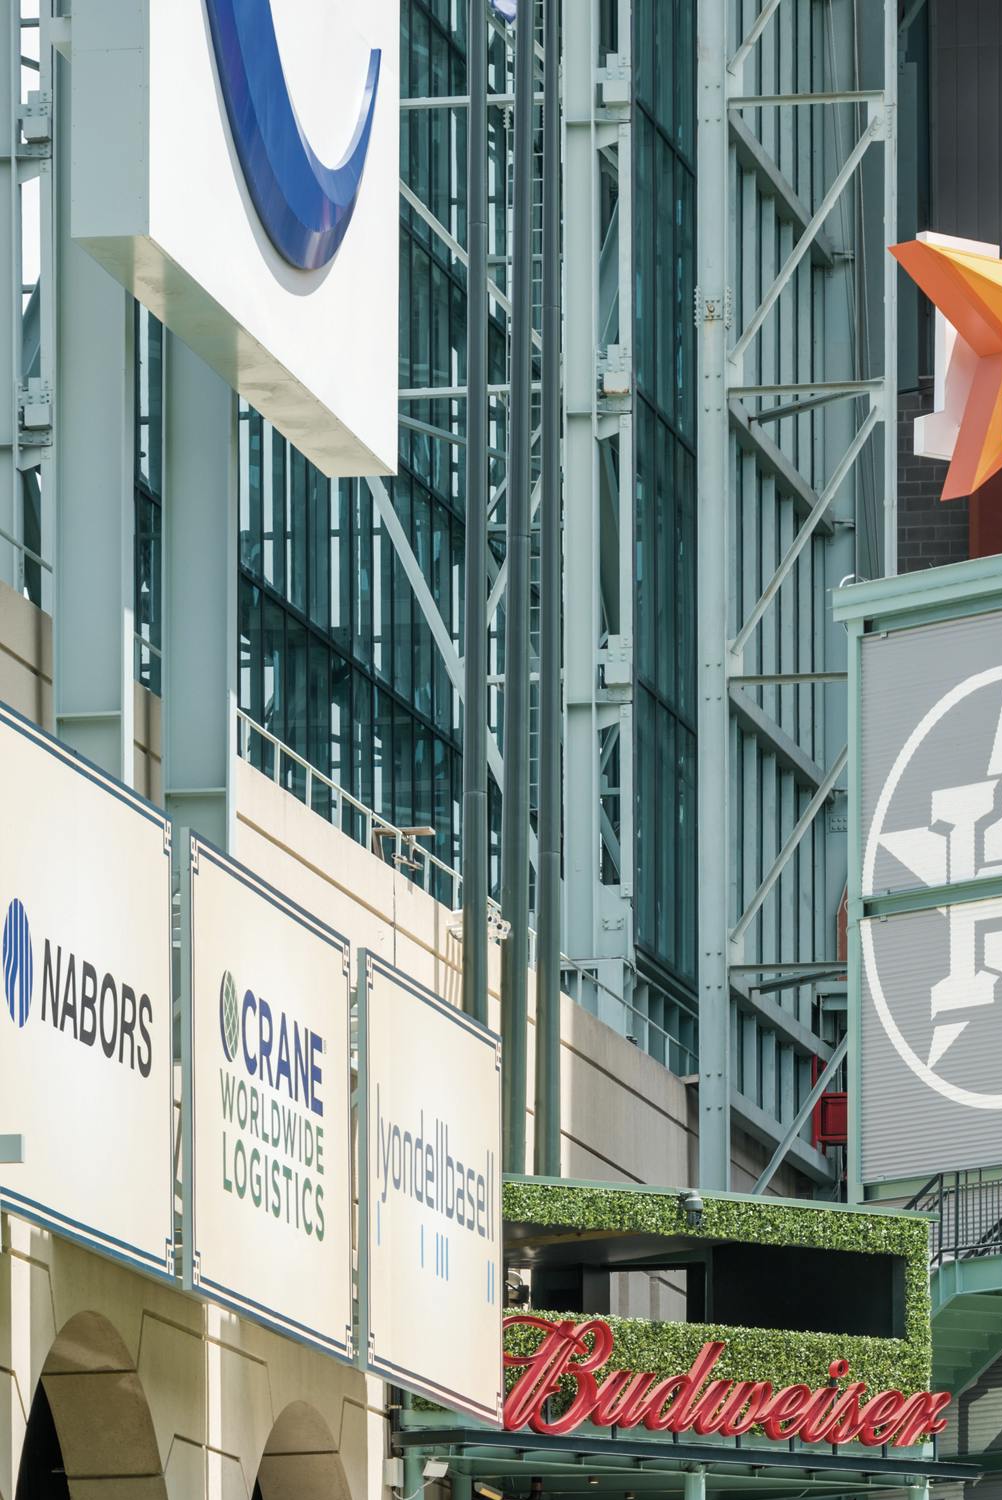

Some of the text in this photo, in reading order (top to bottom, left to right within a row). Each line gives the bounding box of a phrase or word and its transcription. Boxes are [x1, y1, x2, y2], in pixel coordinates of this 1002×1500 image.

[41, 938, 153, 1078] NABORS
[241, 989, 324, 1117] CRANE
[219, 1068, 325, 1175] WORLDWIDE
[222, 1131, 325, 1242] LOGISTICS
[376, 1082, 495, 1243] lyondellbasell
[502, 1315, 952, 1448] Budweiser
